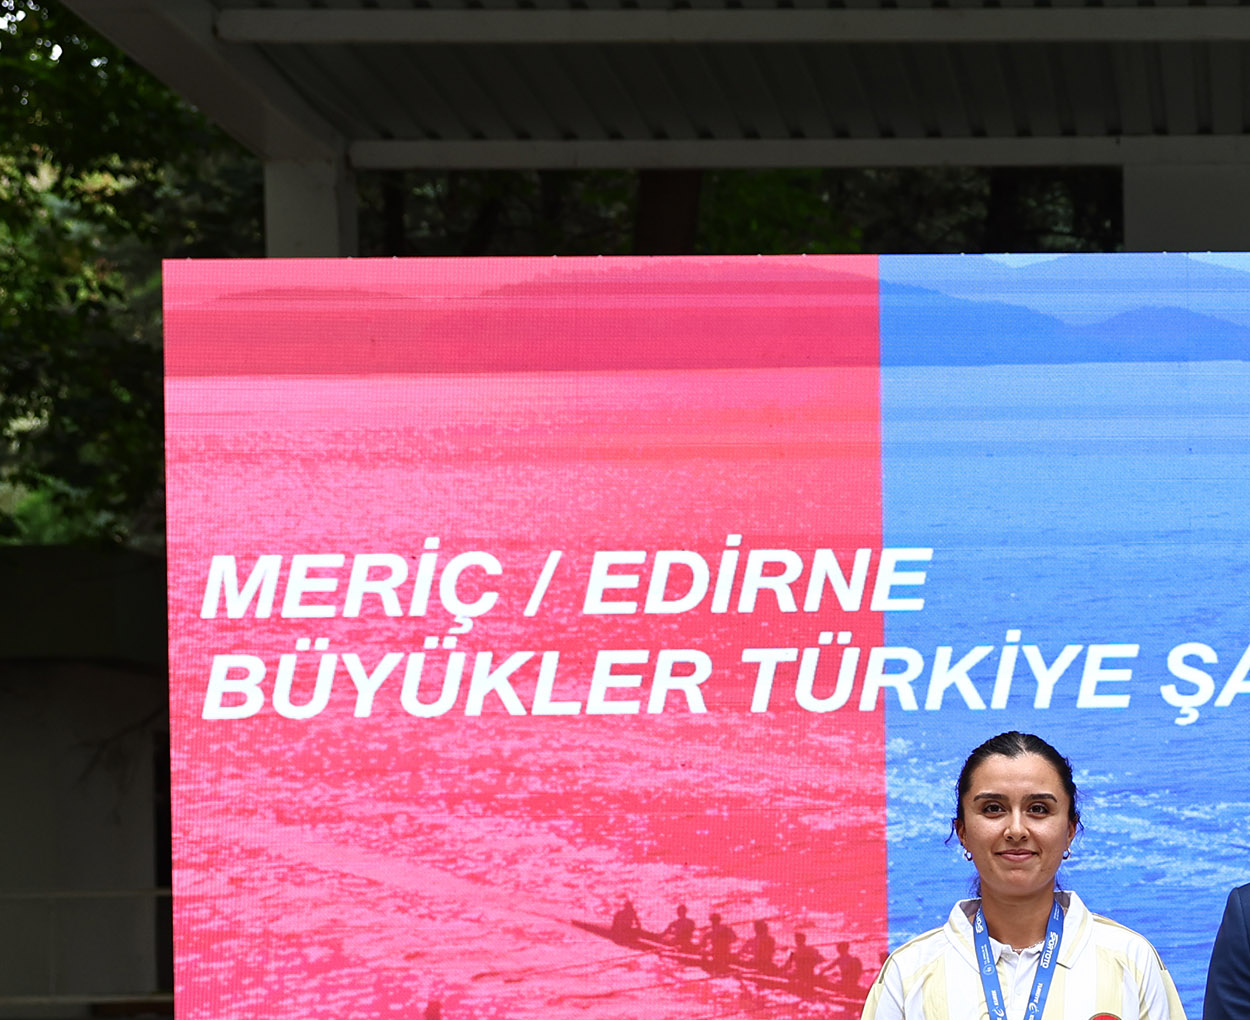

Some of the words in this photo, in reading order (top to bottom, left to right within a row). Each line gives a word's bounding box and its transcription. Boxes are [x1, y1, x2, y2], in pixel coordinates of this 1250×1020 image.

[201, 536, 502, 634] MERİÇ
[523, 550, 563, 617] /
[582, 534, 934, 615] EDİRNE
[201, 636, 713, 720] BÜYÜKLER
[741, 629, 1140, 714] TÜRKİYE
